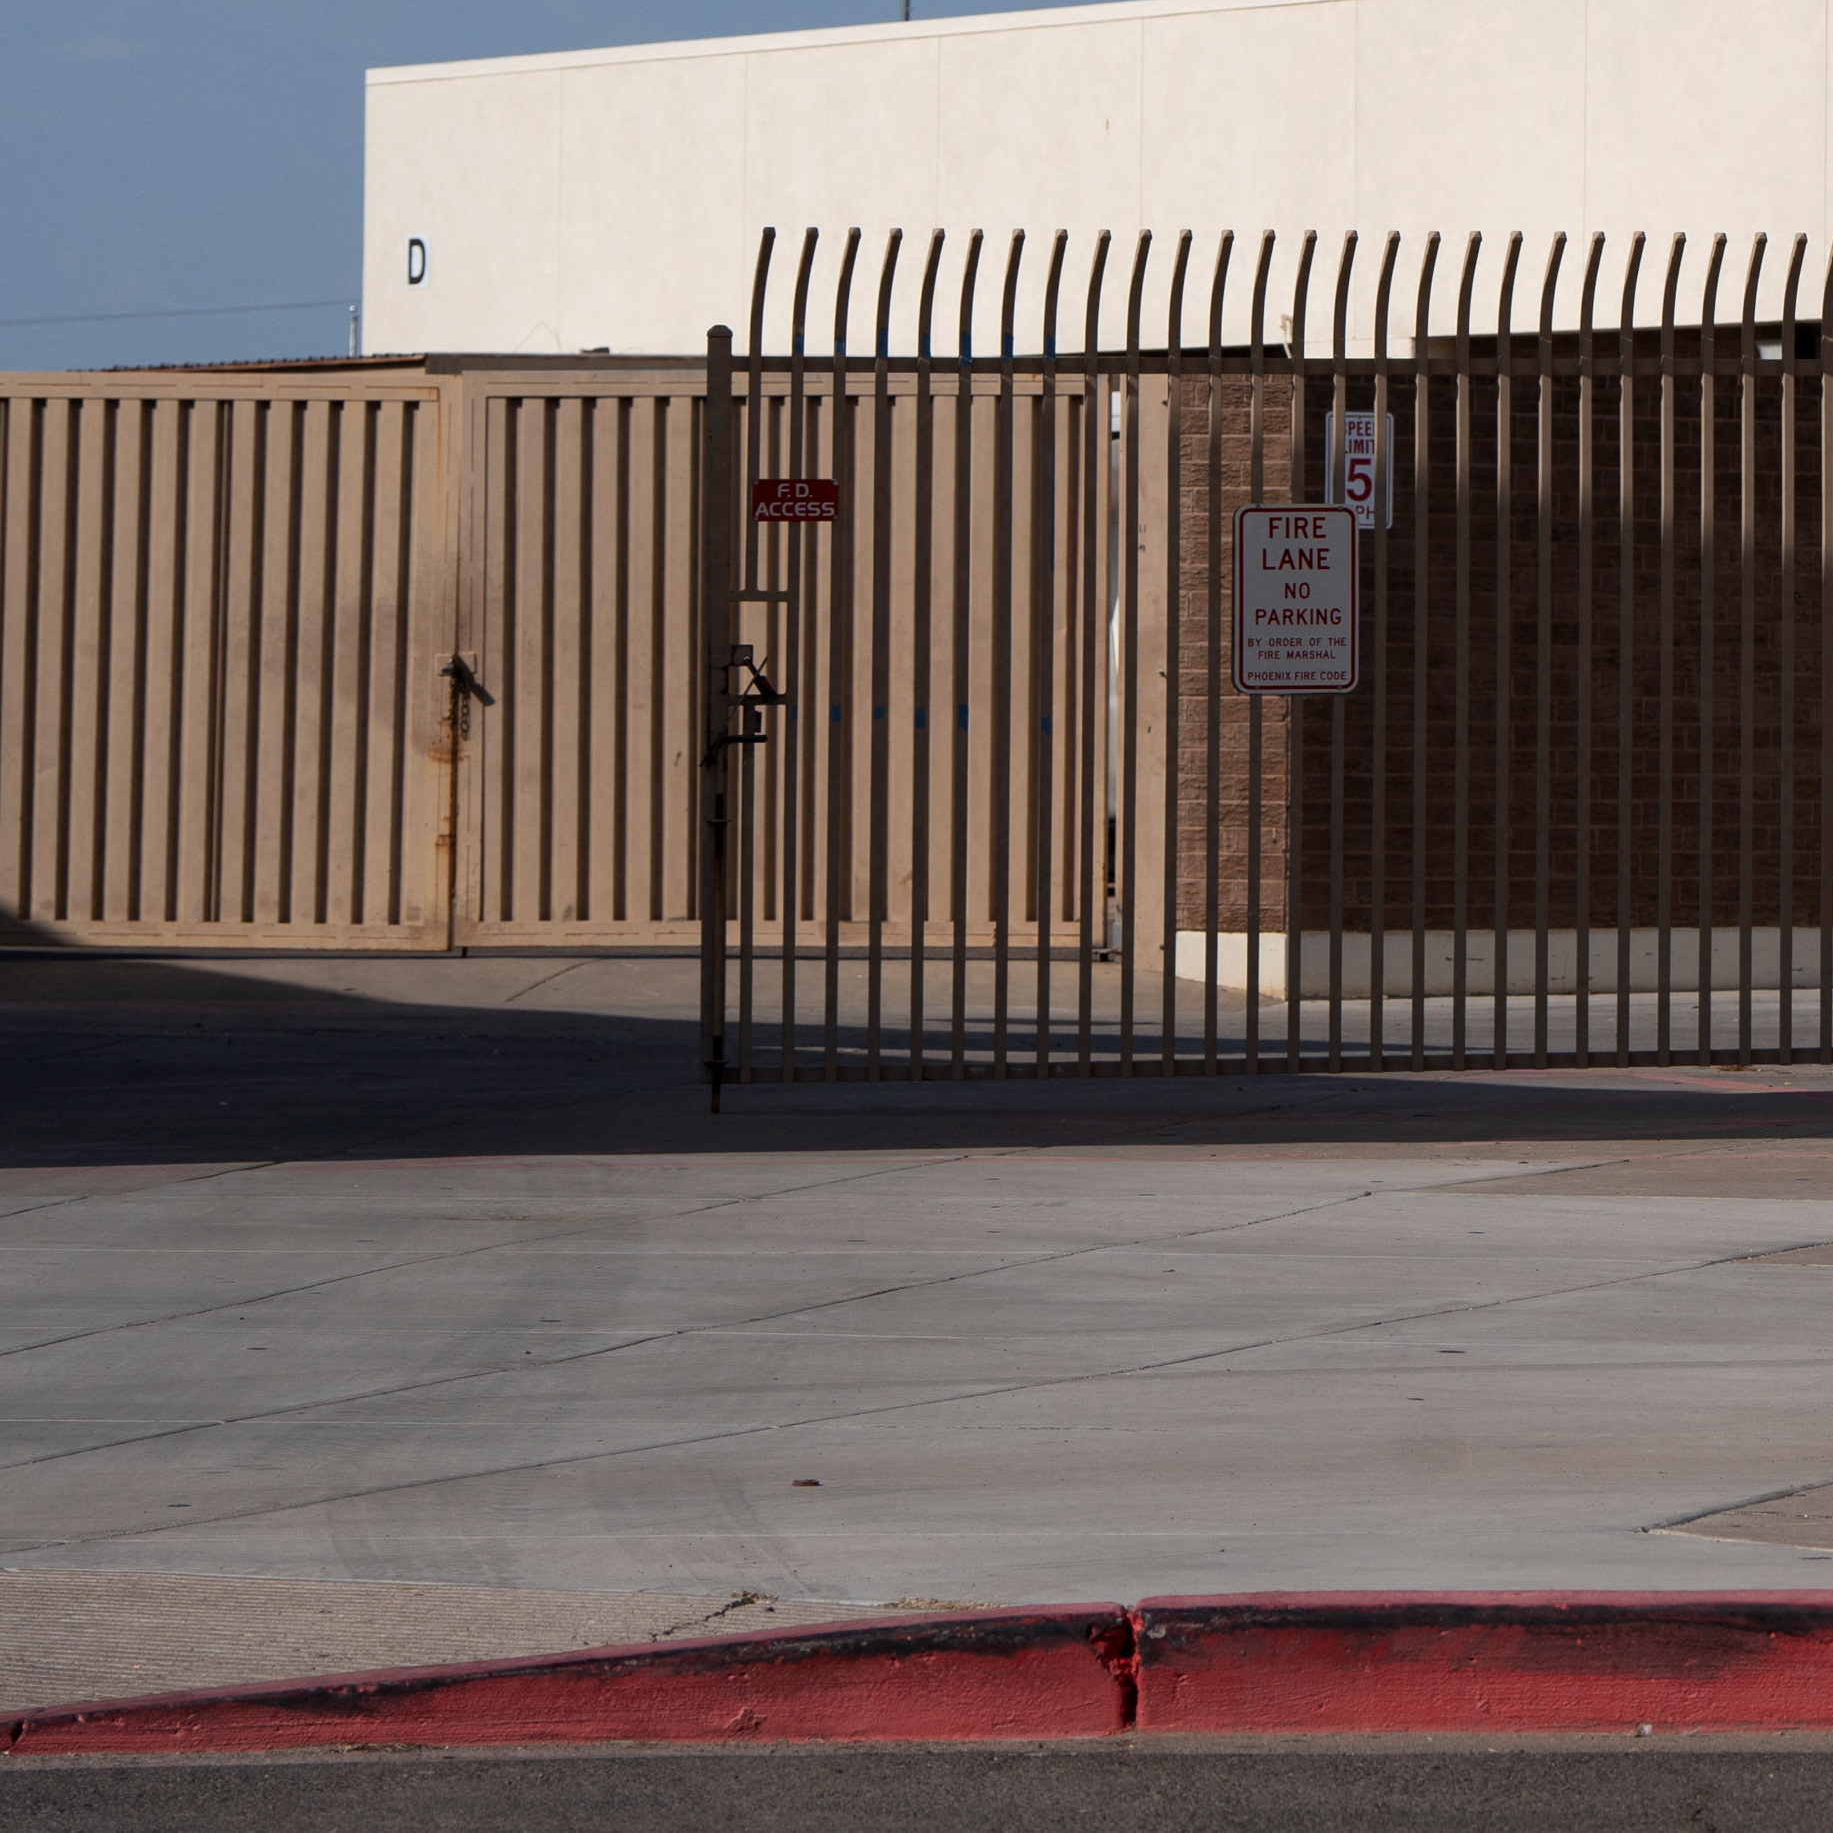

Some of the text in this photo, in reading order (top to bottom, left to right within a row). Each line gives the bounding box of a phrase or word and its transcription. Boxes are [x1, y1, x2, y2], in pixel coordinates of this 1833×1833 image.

[408, 238, 426, 285] D
[1344, 420, 1375, 437] PEE
[1346, 458, 1373, 502] 5
[754, 502, 836, 517] ACCESS
[1269, 516, 1327, 539] FIRE
[1262, 548, 1331, 570] LANE
[1284, 582, 1311, 599] NO
[1255, 608, 1342, 626] PARKING
[1247, 637, 1347, 647] BY ORDER OF THE
[1258, 650, 1336, 660] FIRE MARSHAL
[1247, 671, 1347, 681] PHOENIX FIRE CODE
